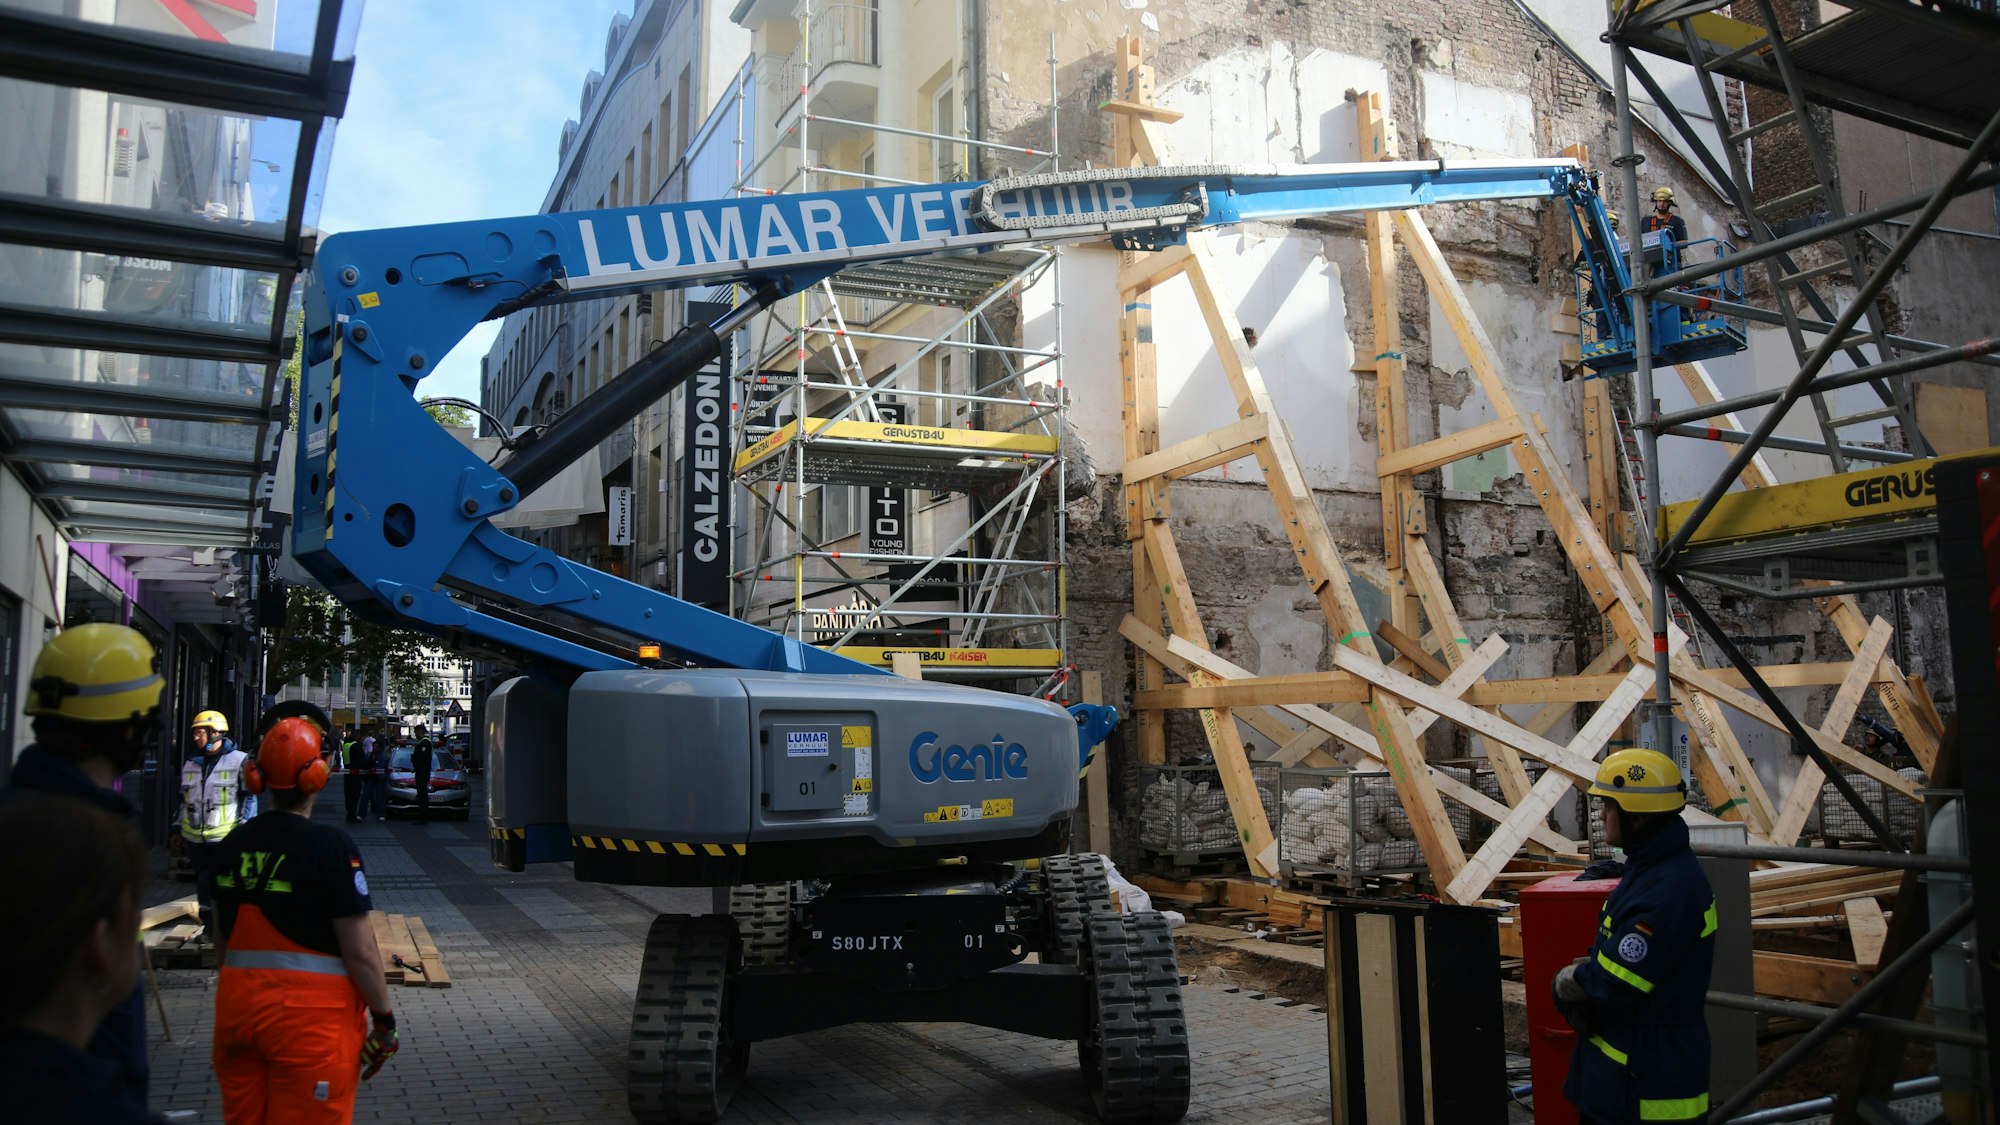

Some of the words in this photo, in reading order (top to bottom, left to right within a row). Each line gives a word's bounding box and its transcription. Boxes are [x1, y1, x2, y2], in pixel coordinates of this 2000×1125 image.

[578, 199, 847, 276] LUMAR
[694, 356, 721, 562] CALZEDONI
[616, 489, 626, 542] tamaris
[871, 539, 903, 548] YOUNG
[949, 652, 987, 661] KAISER
[788, 733, 827, 743] LUMAR
[908, 731, 1028, 784] Genie
[799, 782, 815, 796] 01
[832, 936, 903, 950] S80JTX
[964, 934, 983, 949] 01
